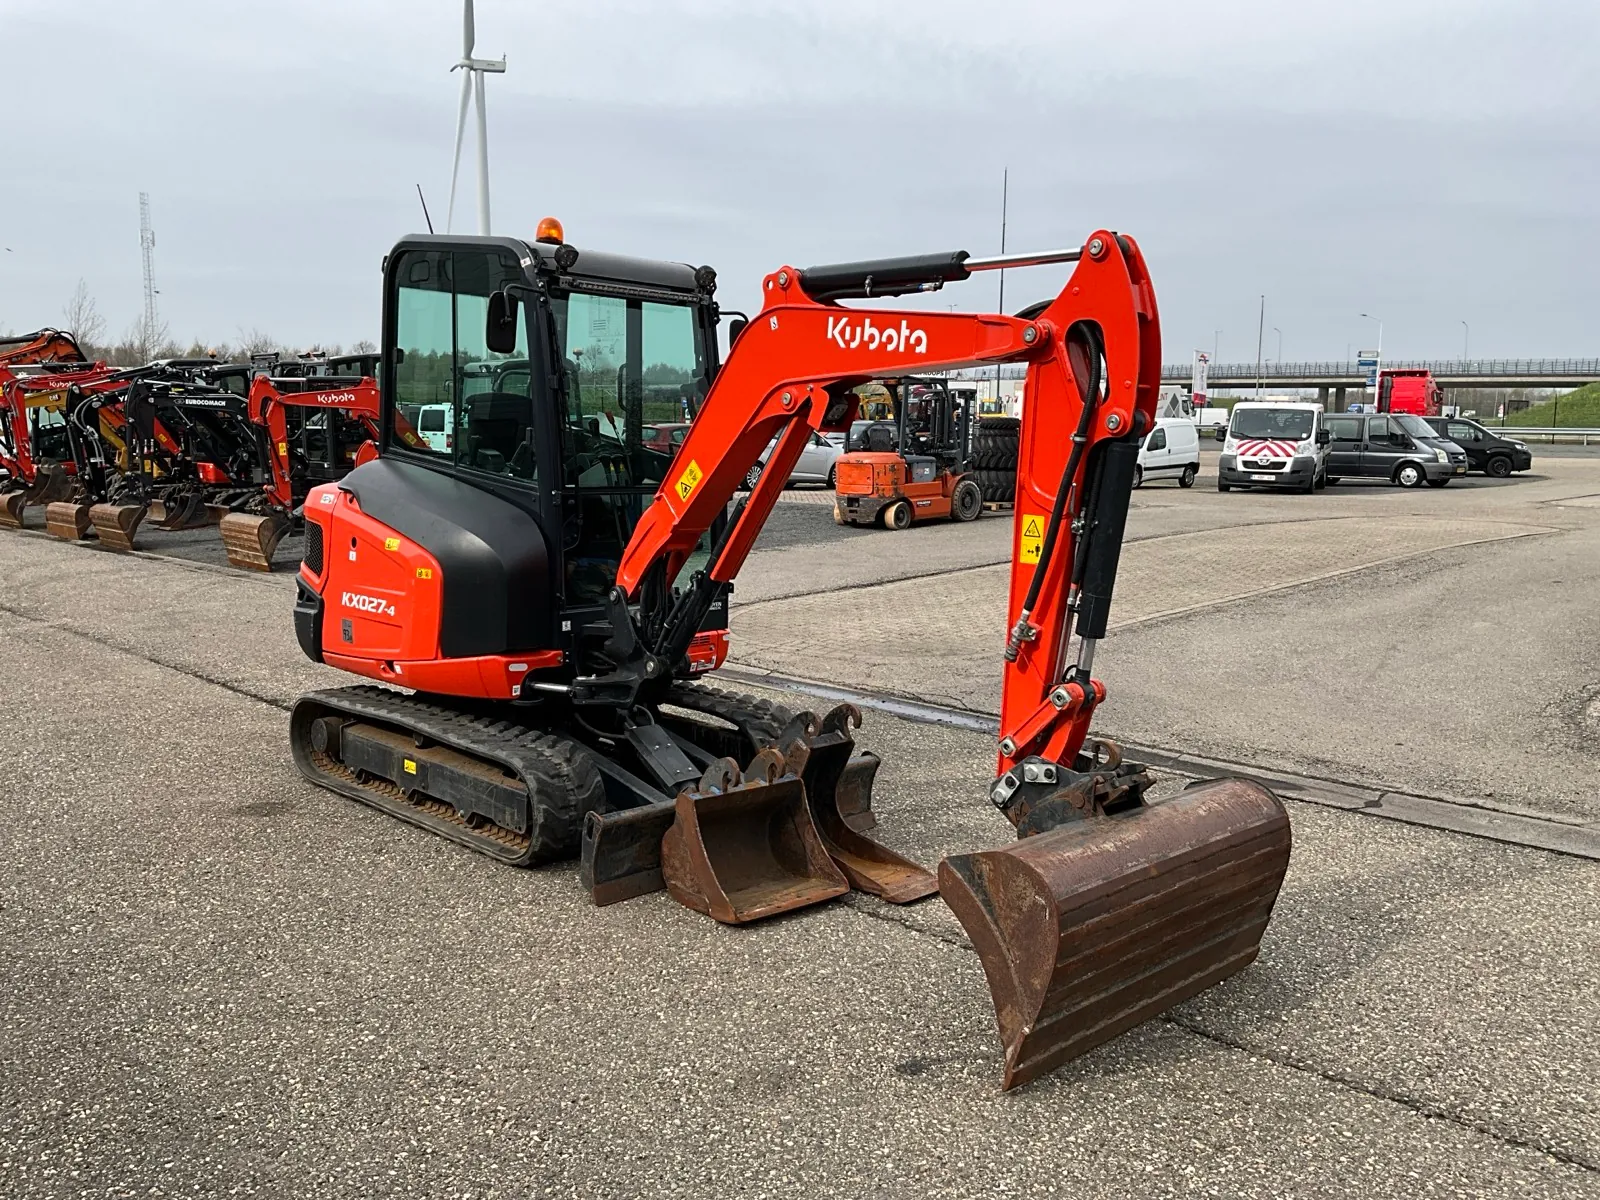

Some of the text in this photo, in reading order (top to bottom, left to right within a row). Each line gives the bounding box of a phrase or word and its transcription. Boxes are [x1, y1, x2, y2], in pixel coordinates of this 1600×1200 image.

[827, 316, 927, 354] Kubota
[185, 398, 226, 406] EUROCOMACH
[317, 392, 355, 404] Kubota
[341, 592, 395, 617] KX027-4
